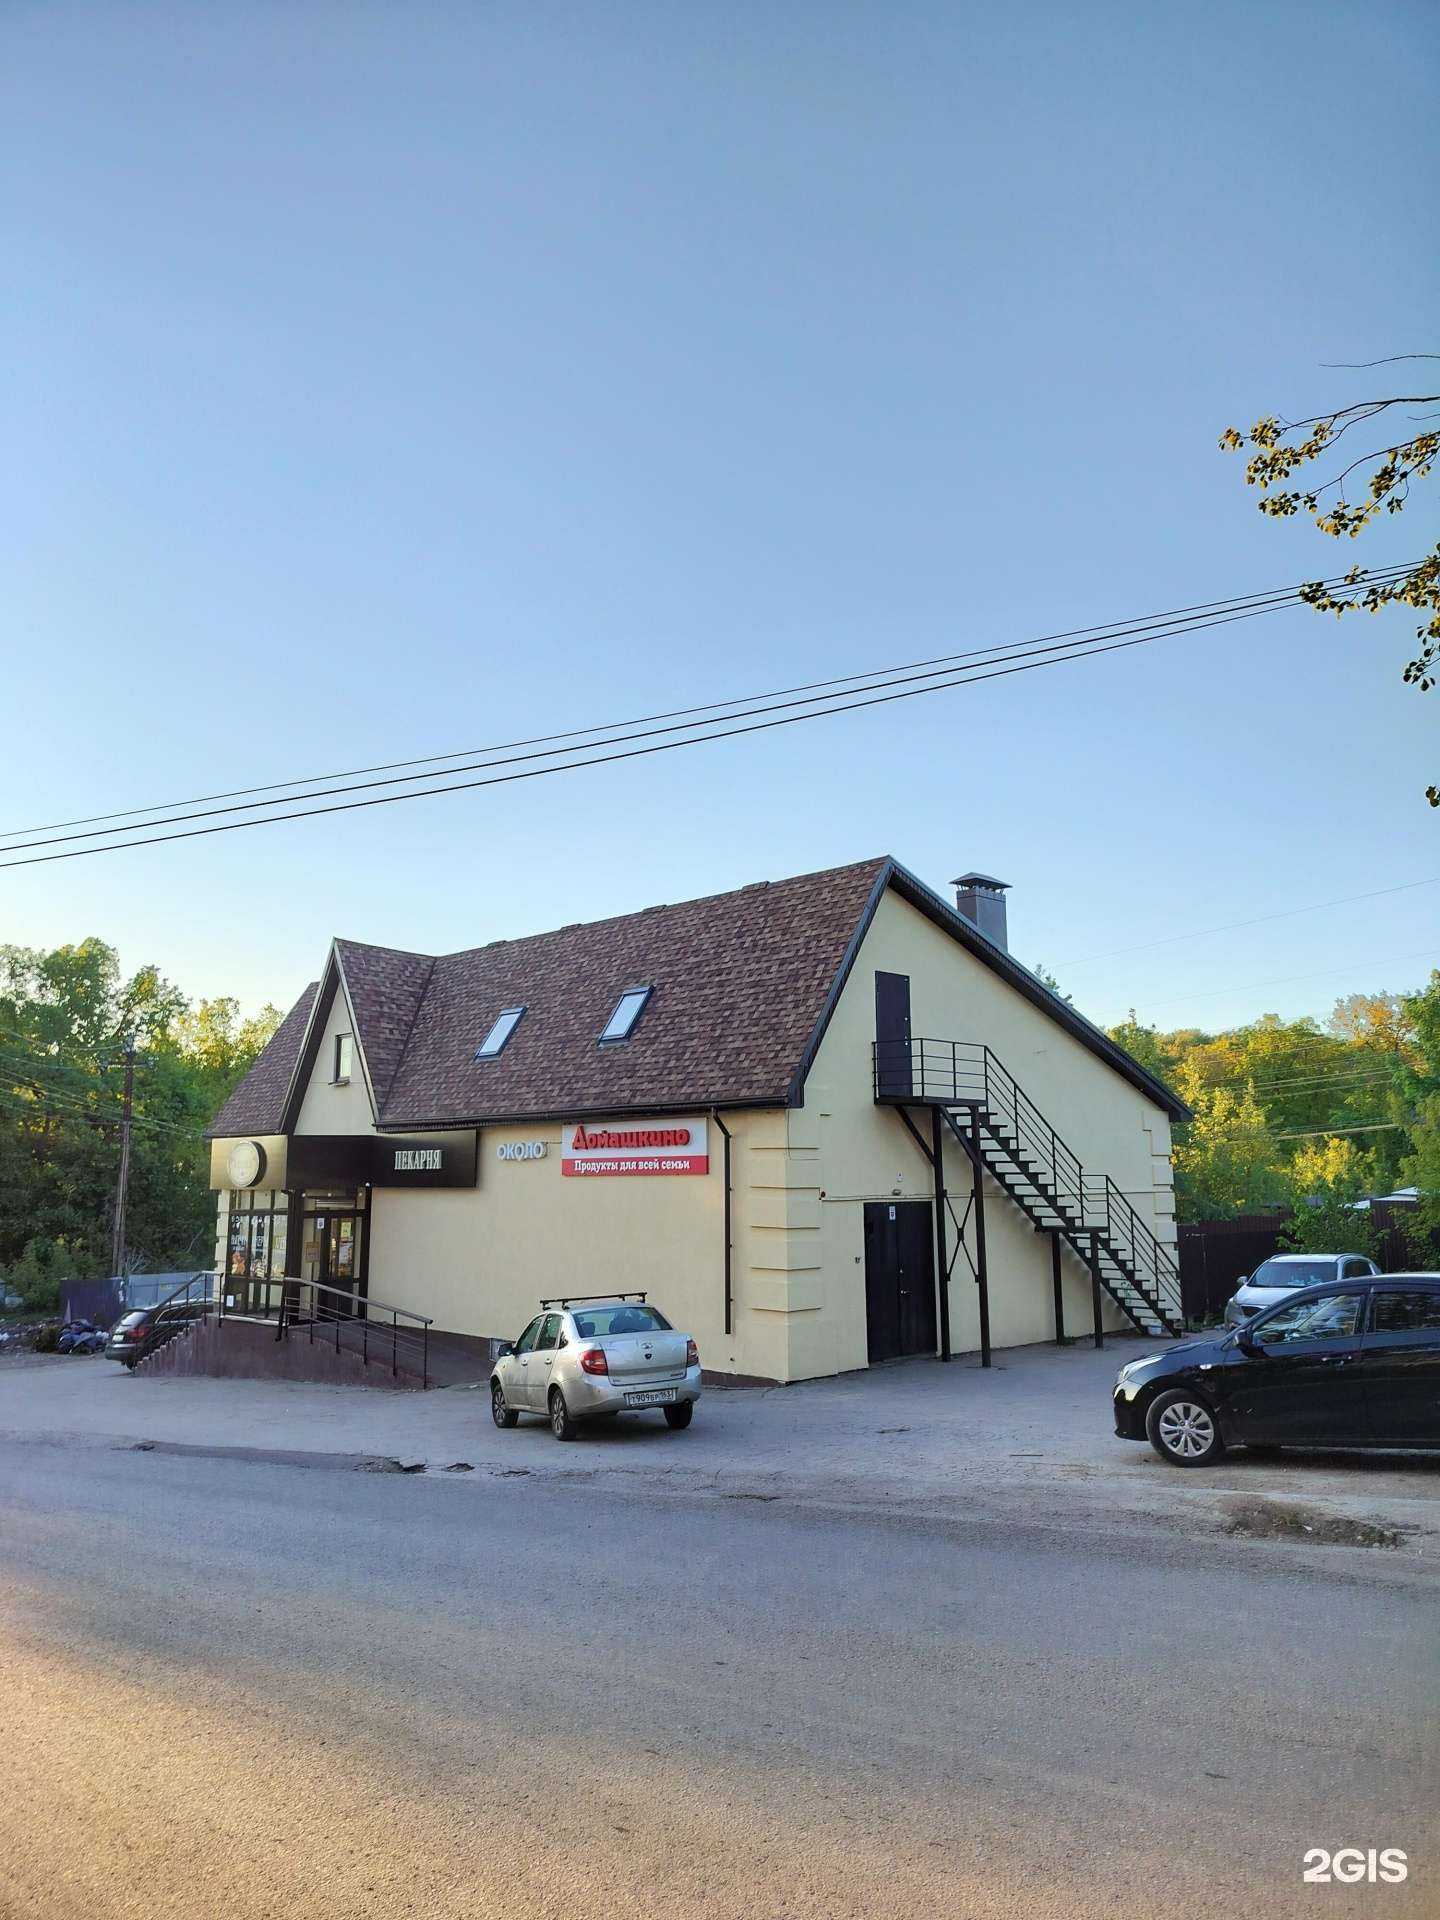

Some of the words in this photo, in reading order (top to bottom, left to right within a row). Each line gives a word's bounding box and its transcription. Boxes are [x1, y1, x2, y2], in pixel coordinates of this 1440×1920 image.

[394, 1150, 442, 1170] ПЕКАРНЯ
[496, 1142, 547, 1161] ОКОЛО
[574, 1159, 618, 1173] Продукты
[619, 1160, 637, 1171] для
[638, 1159, 660, 1170] всей
[661, 1159, 690, 1170] семьи
